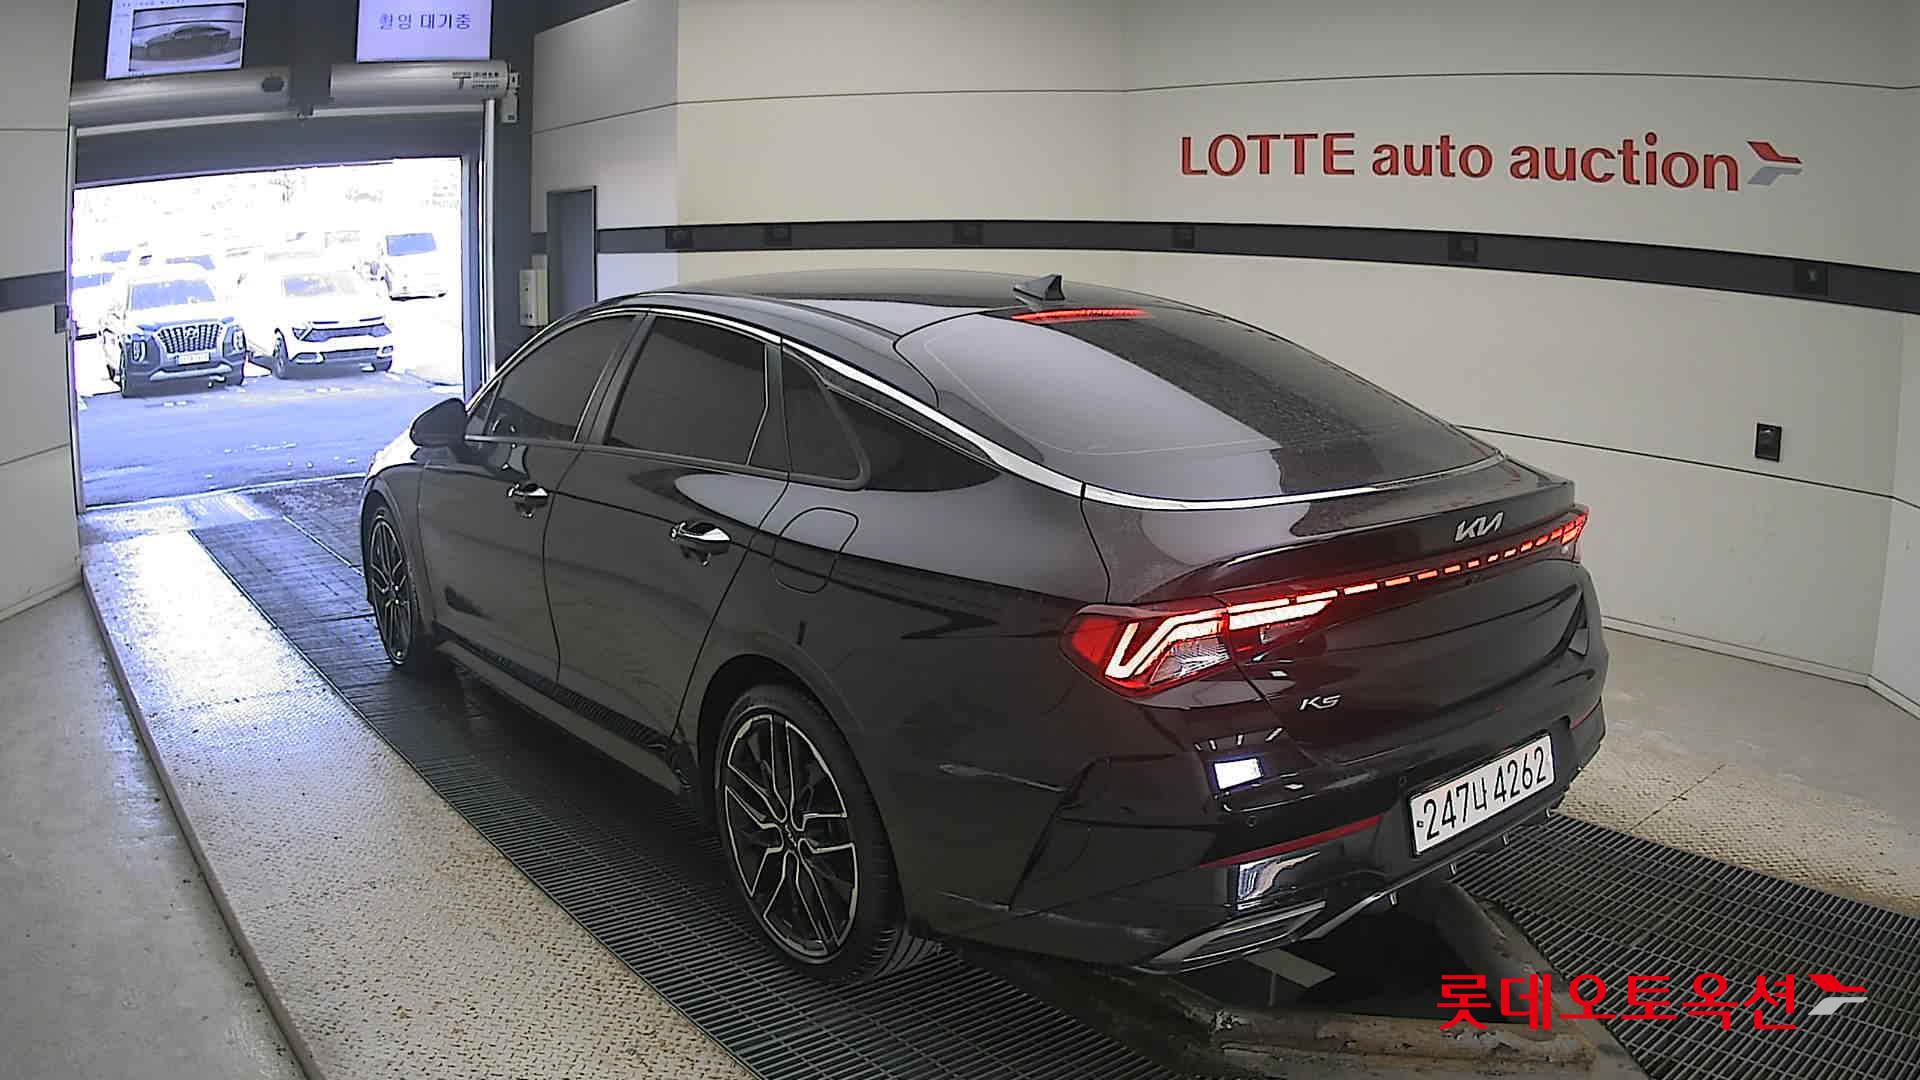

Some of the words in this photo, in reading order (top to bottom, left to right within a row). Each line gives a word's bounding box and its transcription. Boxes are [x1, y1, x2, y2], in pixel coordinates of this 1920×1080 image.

[420, 13, 472, 31] 대기중
[1181, 132, 1356, 177] LOTTE
[1371, 134, 1494, 180] auto
[1509, 131, 1740, 192] auction
[1299, 694, 1343, 711] K5
[1423, 776, 1488, 841] 247나
[1493, 746, 1547, 804] 4262
